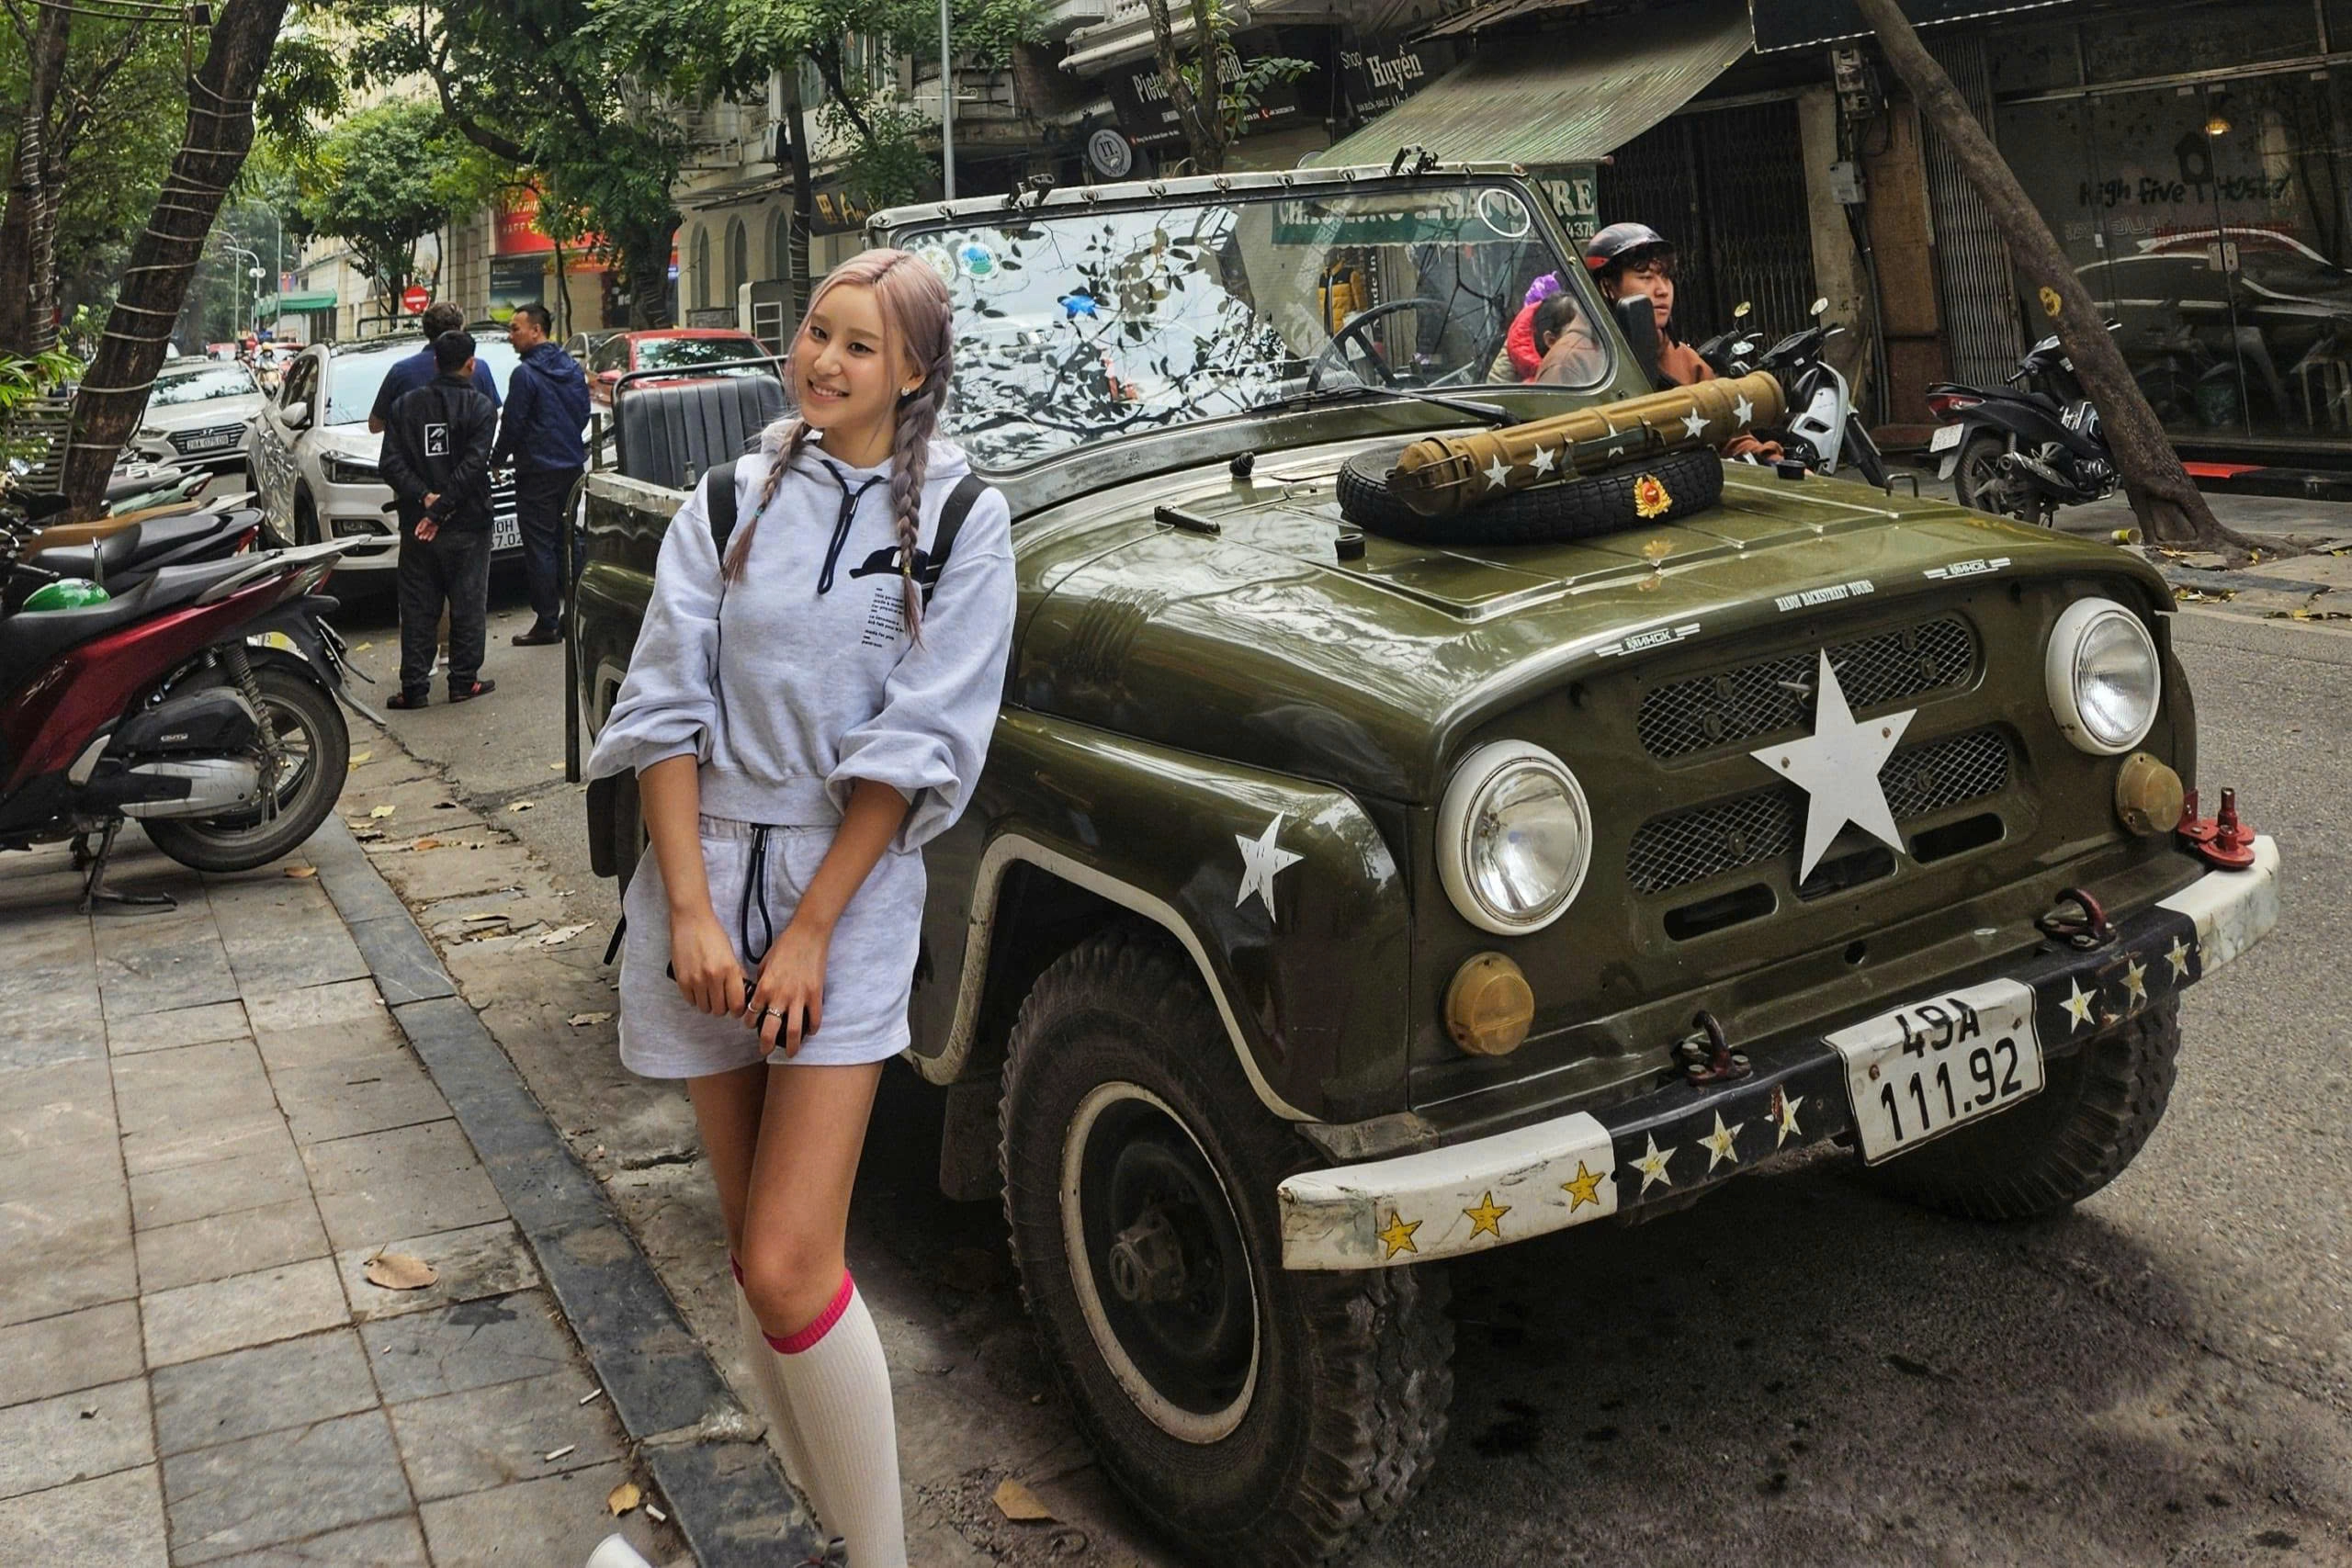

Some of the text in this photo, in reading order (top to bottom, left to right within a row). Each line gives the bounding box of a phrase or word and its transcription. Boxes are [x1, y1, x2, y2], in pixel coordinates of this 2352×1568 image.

[1340, 44, 1424, 91] Shop Huyền
[1543, 178, 1595, 217] RE
[432, 442, 443, 452] 4
[492, 519, 514, 534] 0H
[492, 532, 522, 548] 7.02
[1894, 998, 1981, 1058] 49A
[1880, 1036, 2023, 1142] 111.92
